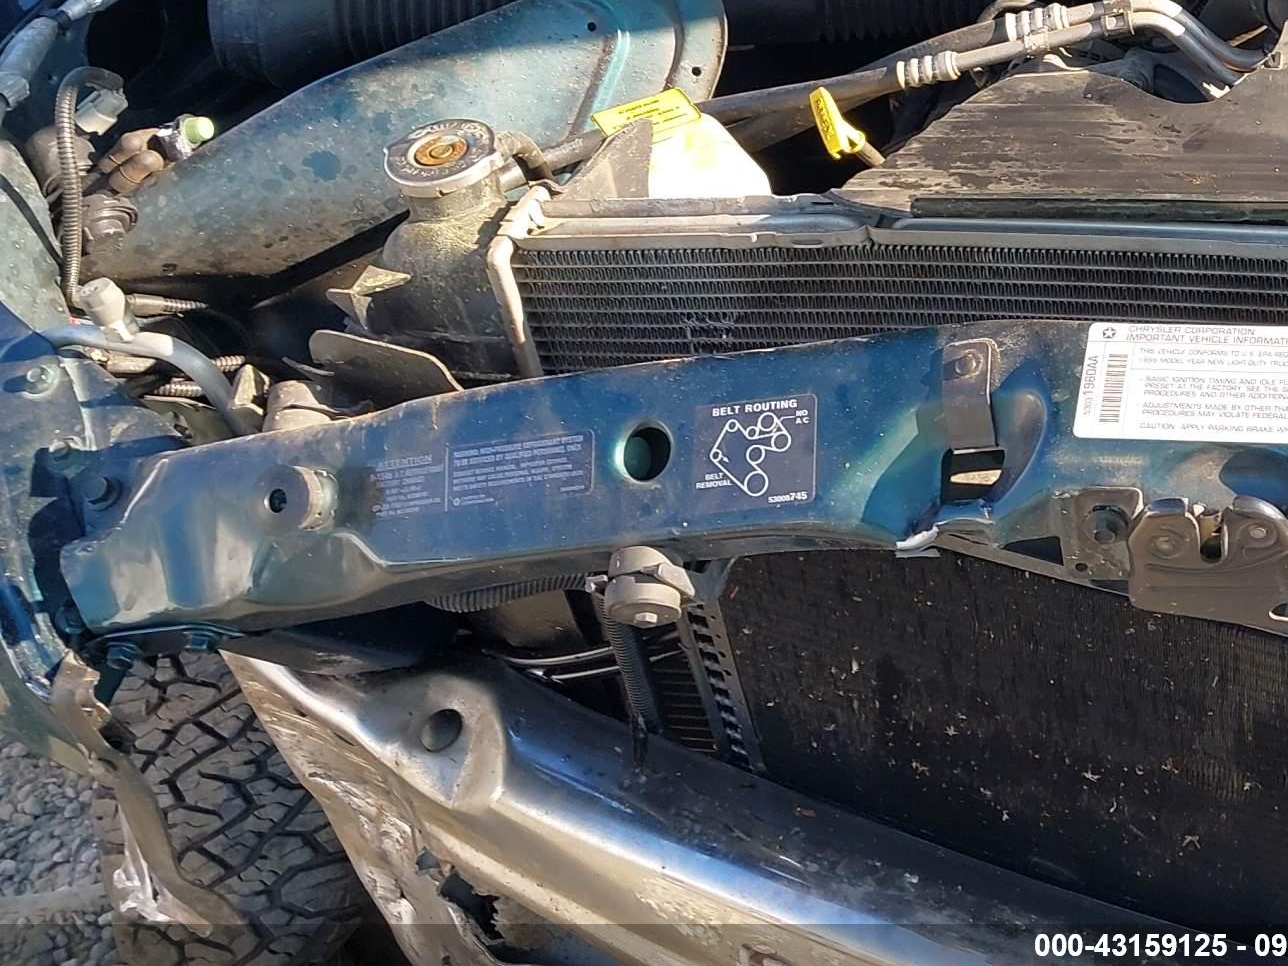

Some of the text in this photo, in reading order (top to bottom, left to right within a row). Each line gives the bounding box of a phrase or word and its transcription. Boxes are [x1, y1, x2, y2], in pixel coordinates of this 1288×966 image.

[1185, 327, 1256, 335] CORPORATION
[1126, 334, 1186, 342] IMPORTANT
[712, 399, 797, 417] BELT ROUTING
[1142, 409, 1196, 417] PROCEDURES
[1252, 412, 1288, 420] FEDERAL
[696, 479, 731, 489] REMOVAL
